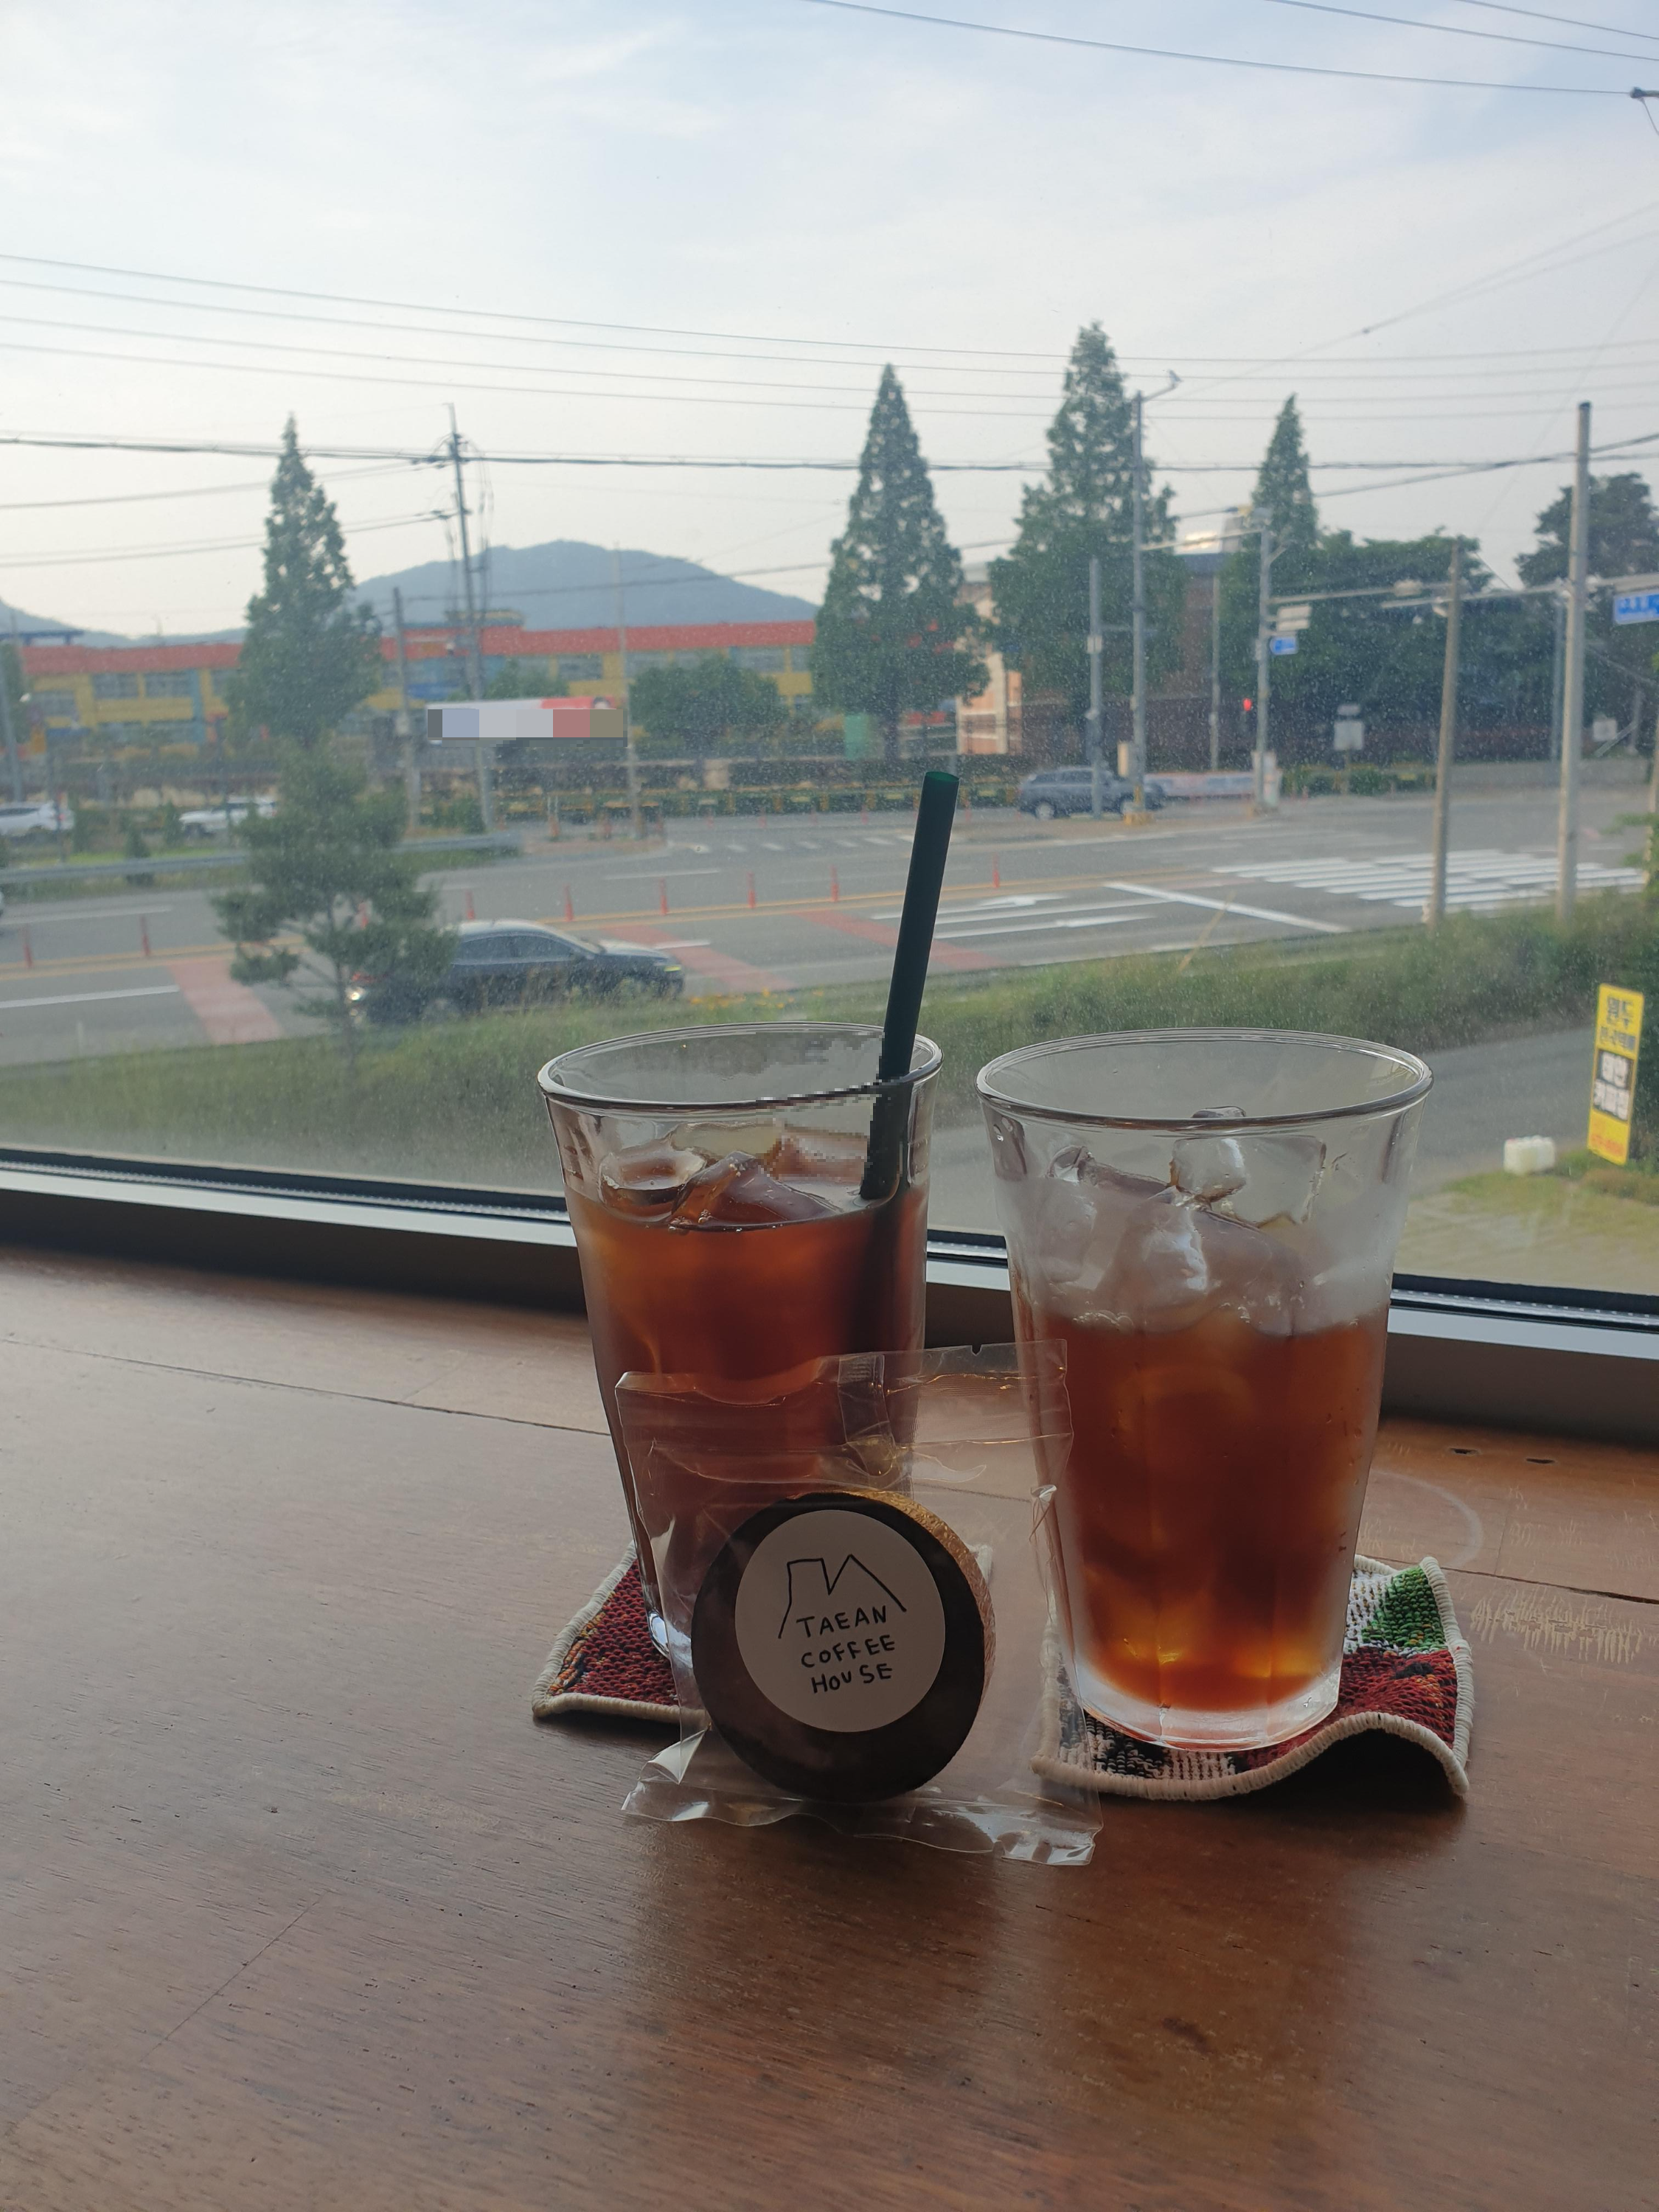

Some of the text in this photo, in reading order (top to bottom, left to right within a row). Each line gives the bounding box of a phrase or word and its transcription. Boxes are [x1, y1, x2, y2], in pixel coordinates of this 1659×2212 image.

[796, 1605, 887, 1638] TAEAN
[801, 1635, 895, 1668] COFFEE
[811, 1663, 893, 1694] HOUSE
